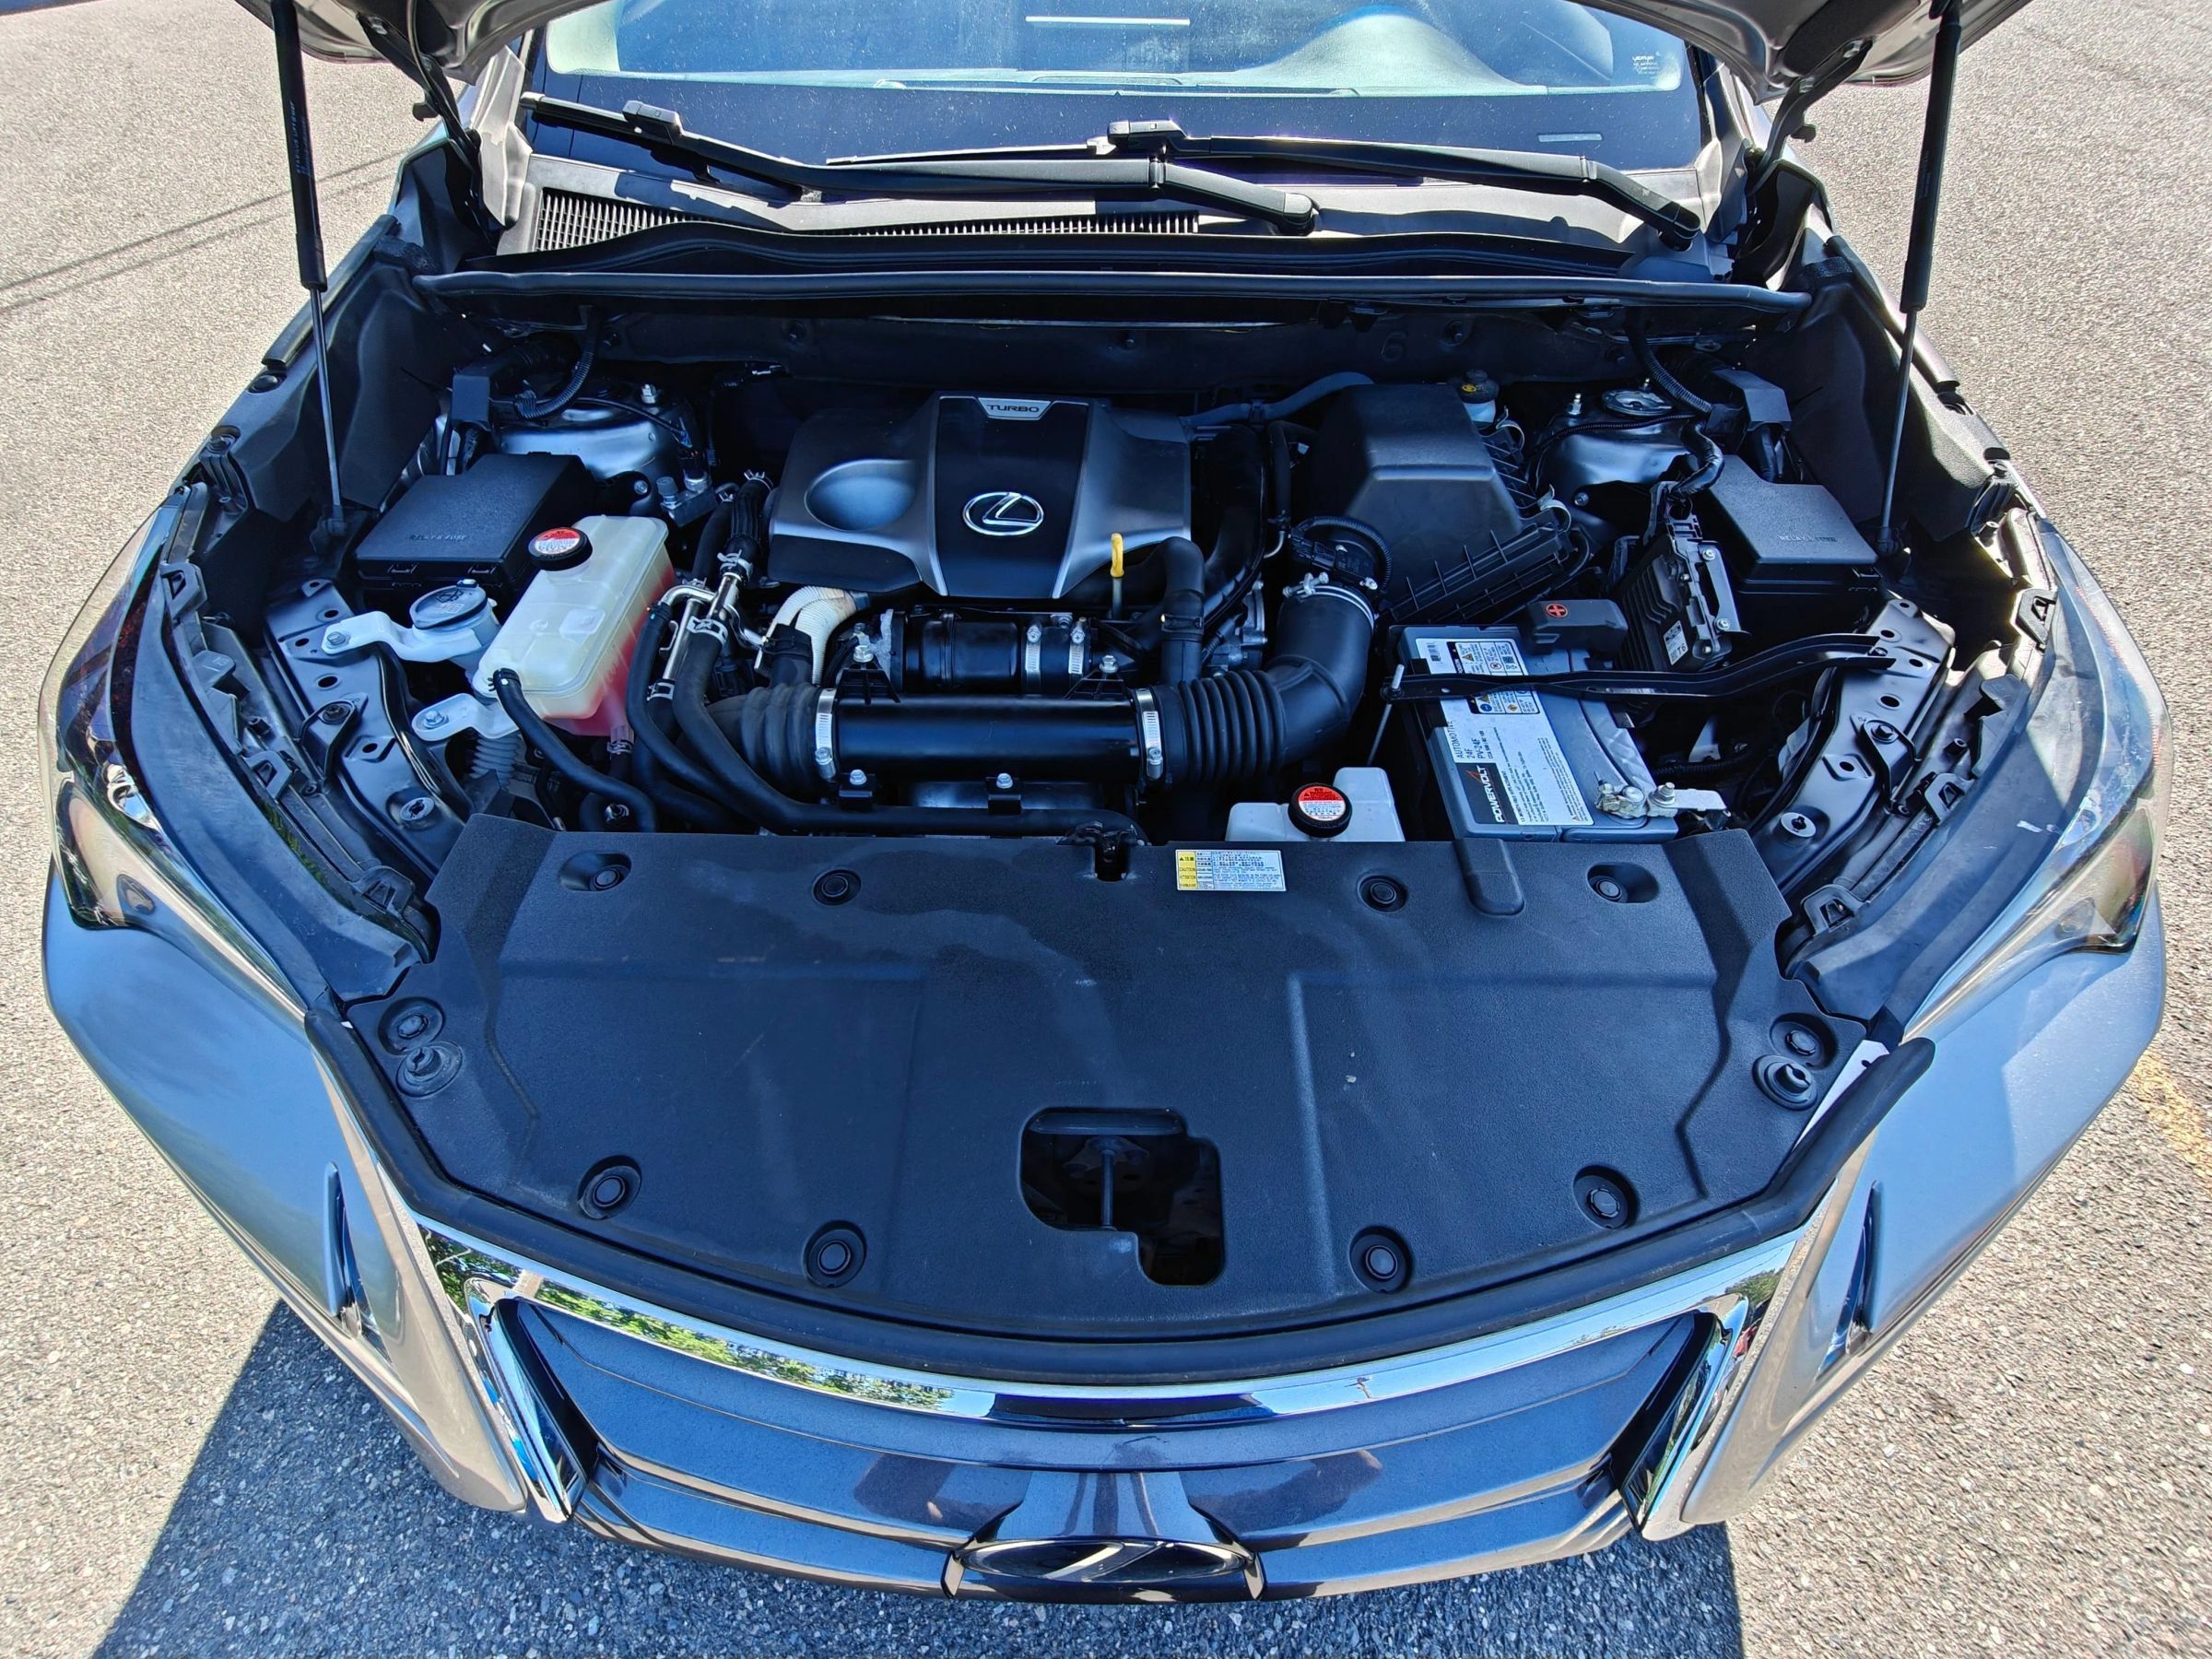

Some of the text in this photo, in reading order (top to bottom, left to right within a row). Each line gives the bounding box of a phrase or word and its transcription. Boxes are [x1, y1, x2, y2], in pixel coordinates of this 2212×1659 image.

[986, 404, 1040, 413] TURBO
[1447, 720, 1465, 759] AUTOMOTIVE
[1471, 737, 1486, 759] PV-24F
[1464, 747, 1475, 759] 24F
[1476, 764, 1505, 823] POWERVOLT
